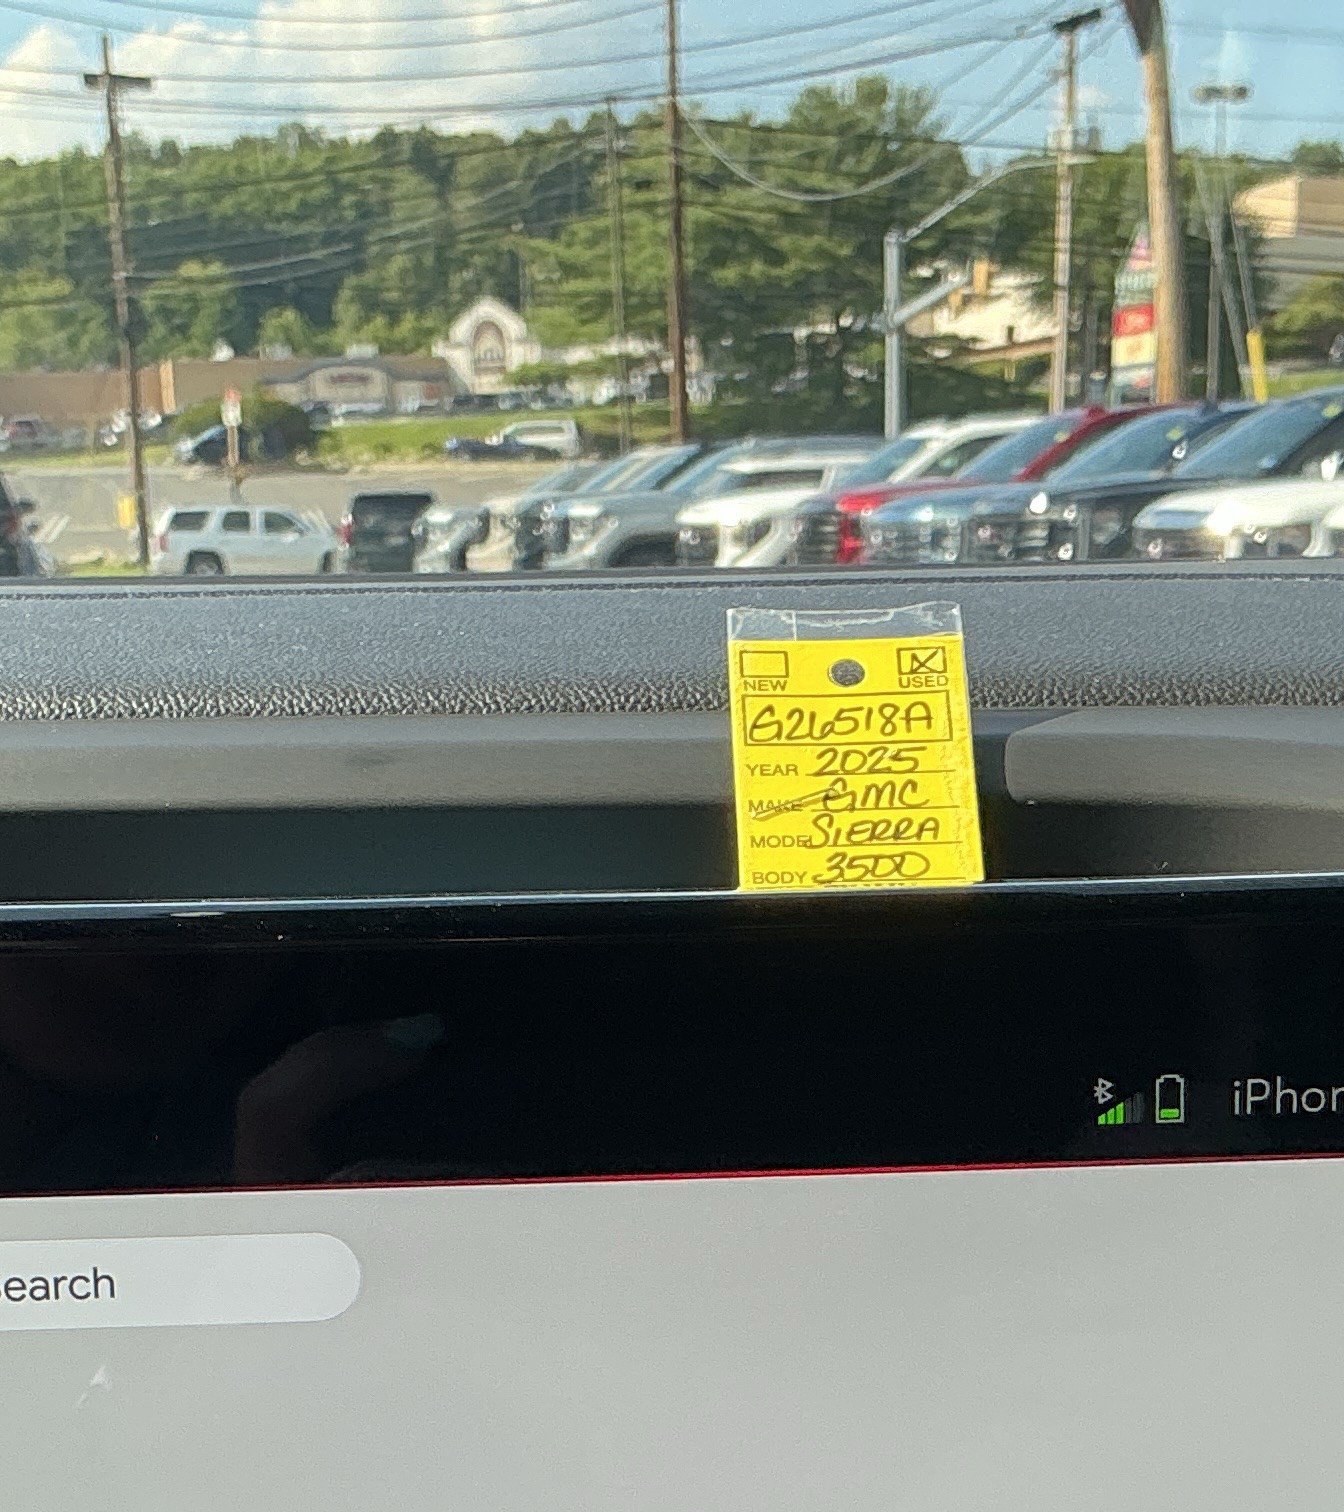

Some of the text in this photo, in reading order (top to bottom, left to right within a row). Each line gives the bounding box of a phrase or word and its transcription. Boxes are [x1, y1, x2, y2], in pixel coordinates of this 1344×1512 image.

[743, 679, 788, 692] NEW
[898, 675, 949, 689] USED
[749, 701, 933, 742] G26518A
[746, 746, 927, 777] YEAR 2025
[748, 777, 930, 814] MAKE GMC
[750, 812, 940, 849] MODEL SIERRA
[752, 851, 931, 885] BODY 3500
